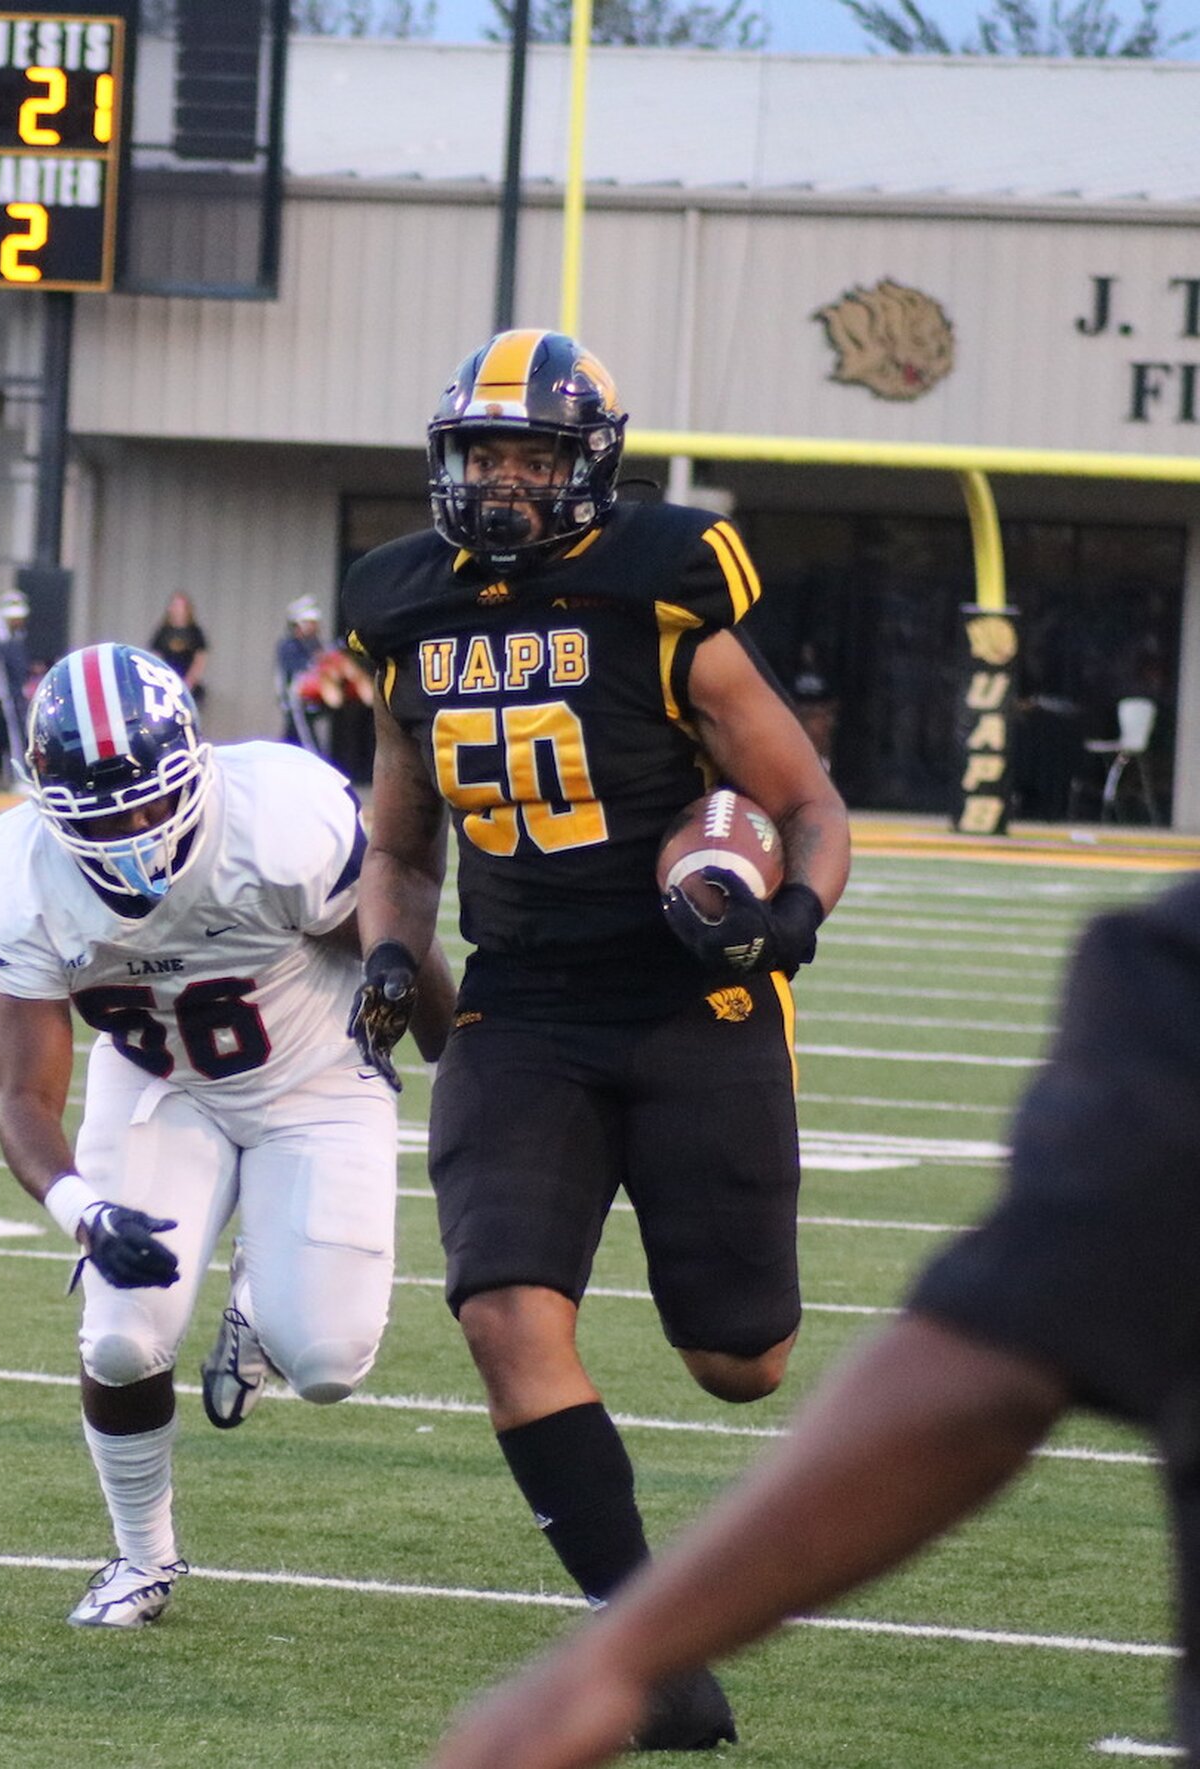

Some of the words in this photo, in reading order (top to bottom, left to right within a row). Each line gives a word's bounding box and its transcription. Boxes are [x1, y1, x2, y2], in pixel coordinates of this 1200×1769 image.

[19, 66, 114, 146] 21
[0, 202, 48, 282] 2
[1075, 274, 1132, 336] J.
[419, 629, 589, 695] UAPB
[432, 701, 608, 857] 50
[127, 959, 184, 975] LANE
